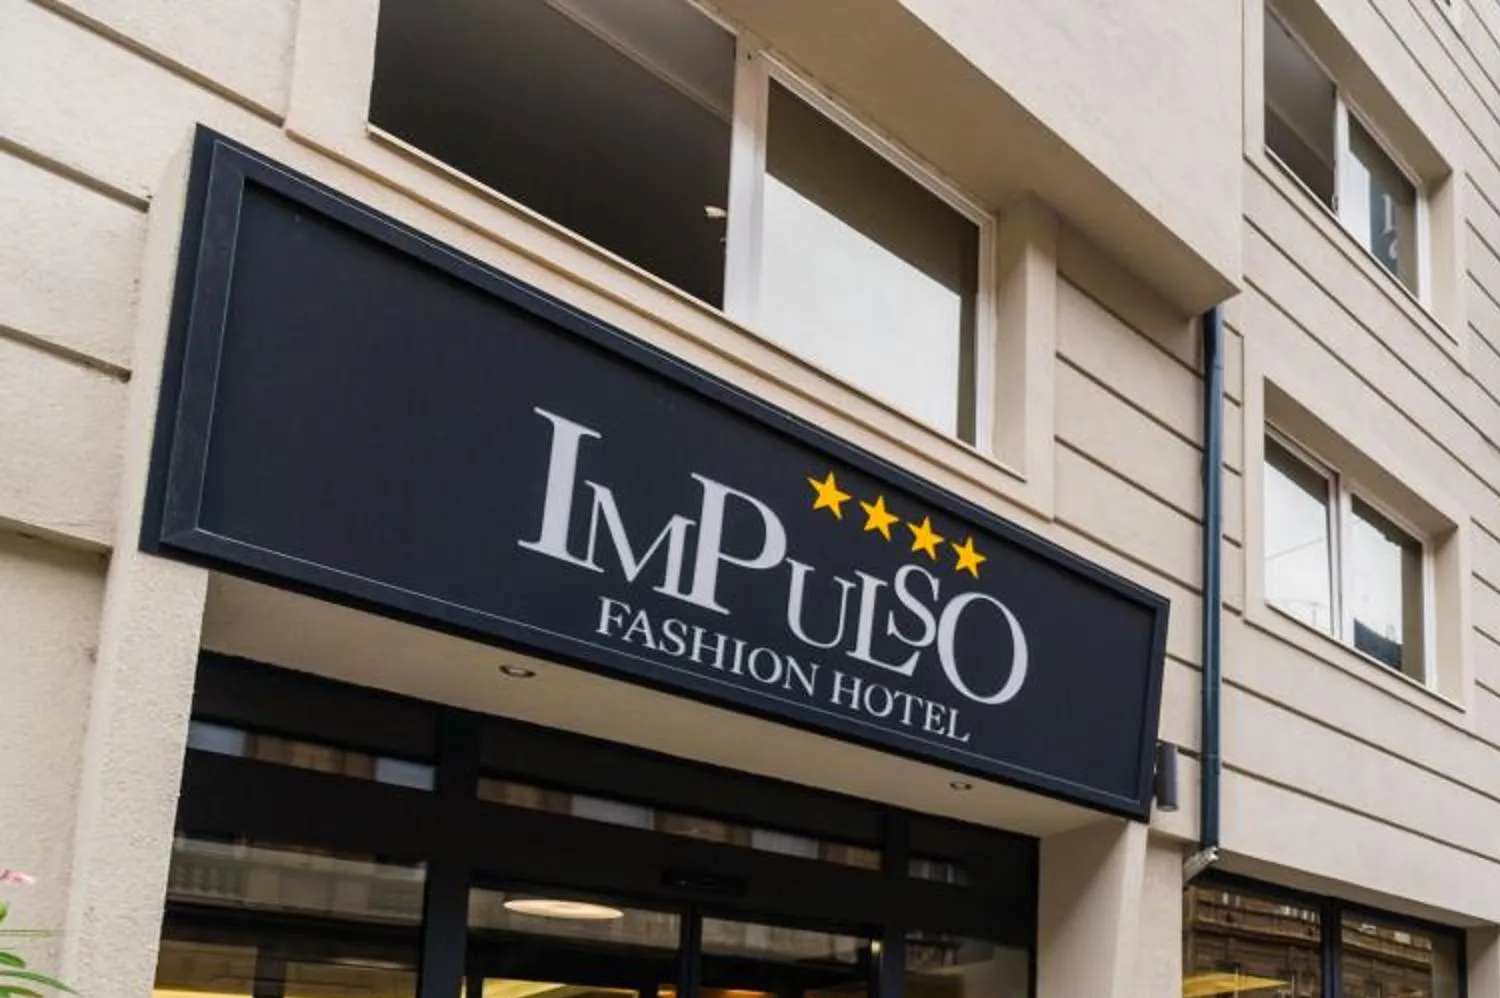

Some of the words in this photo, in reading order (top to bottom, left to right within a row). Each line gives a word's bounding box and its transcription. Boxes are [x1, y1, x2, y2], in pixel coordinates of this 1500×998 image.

[517, 406, 1029, 705] IMPULSO
[595, 595, 821, 697] FASHION
[830, 669, 972, 743] HOTEL
